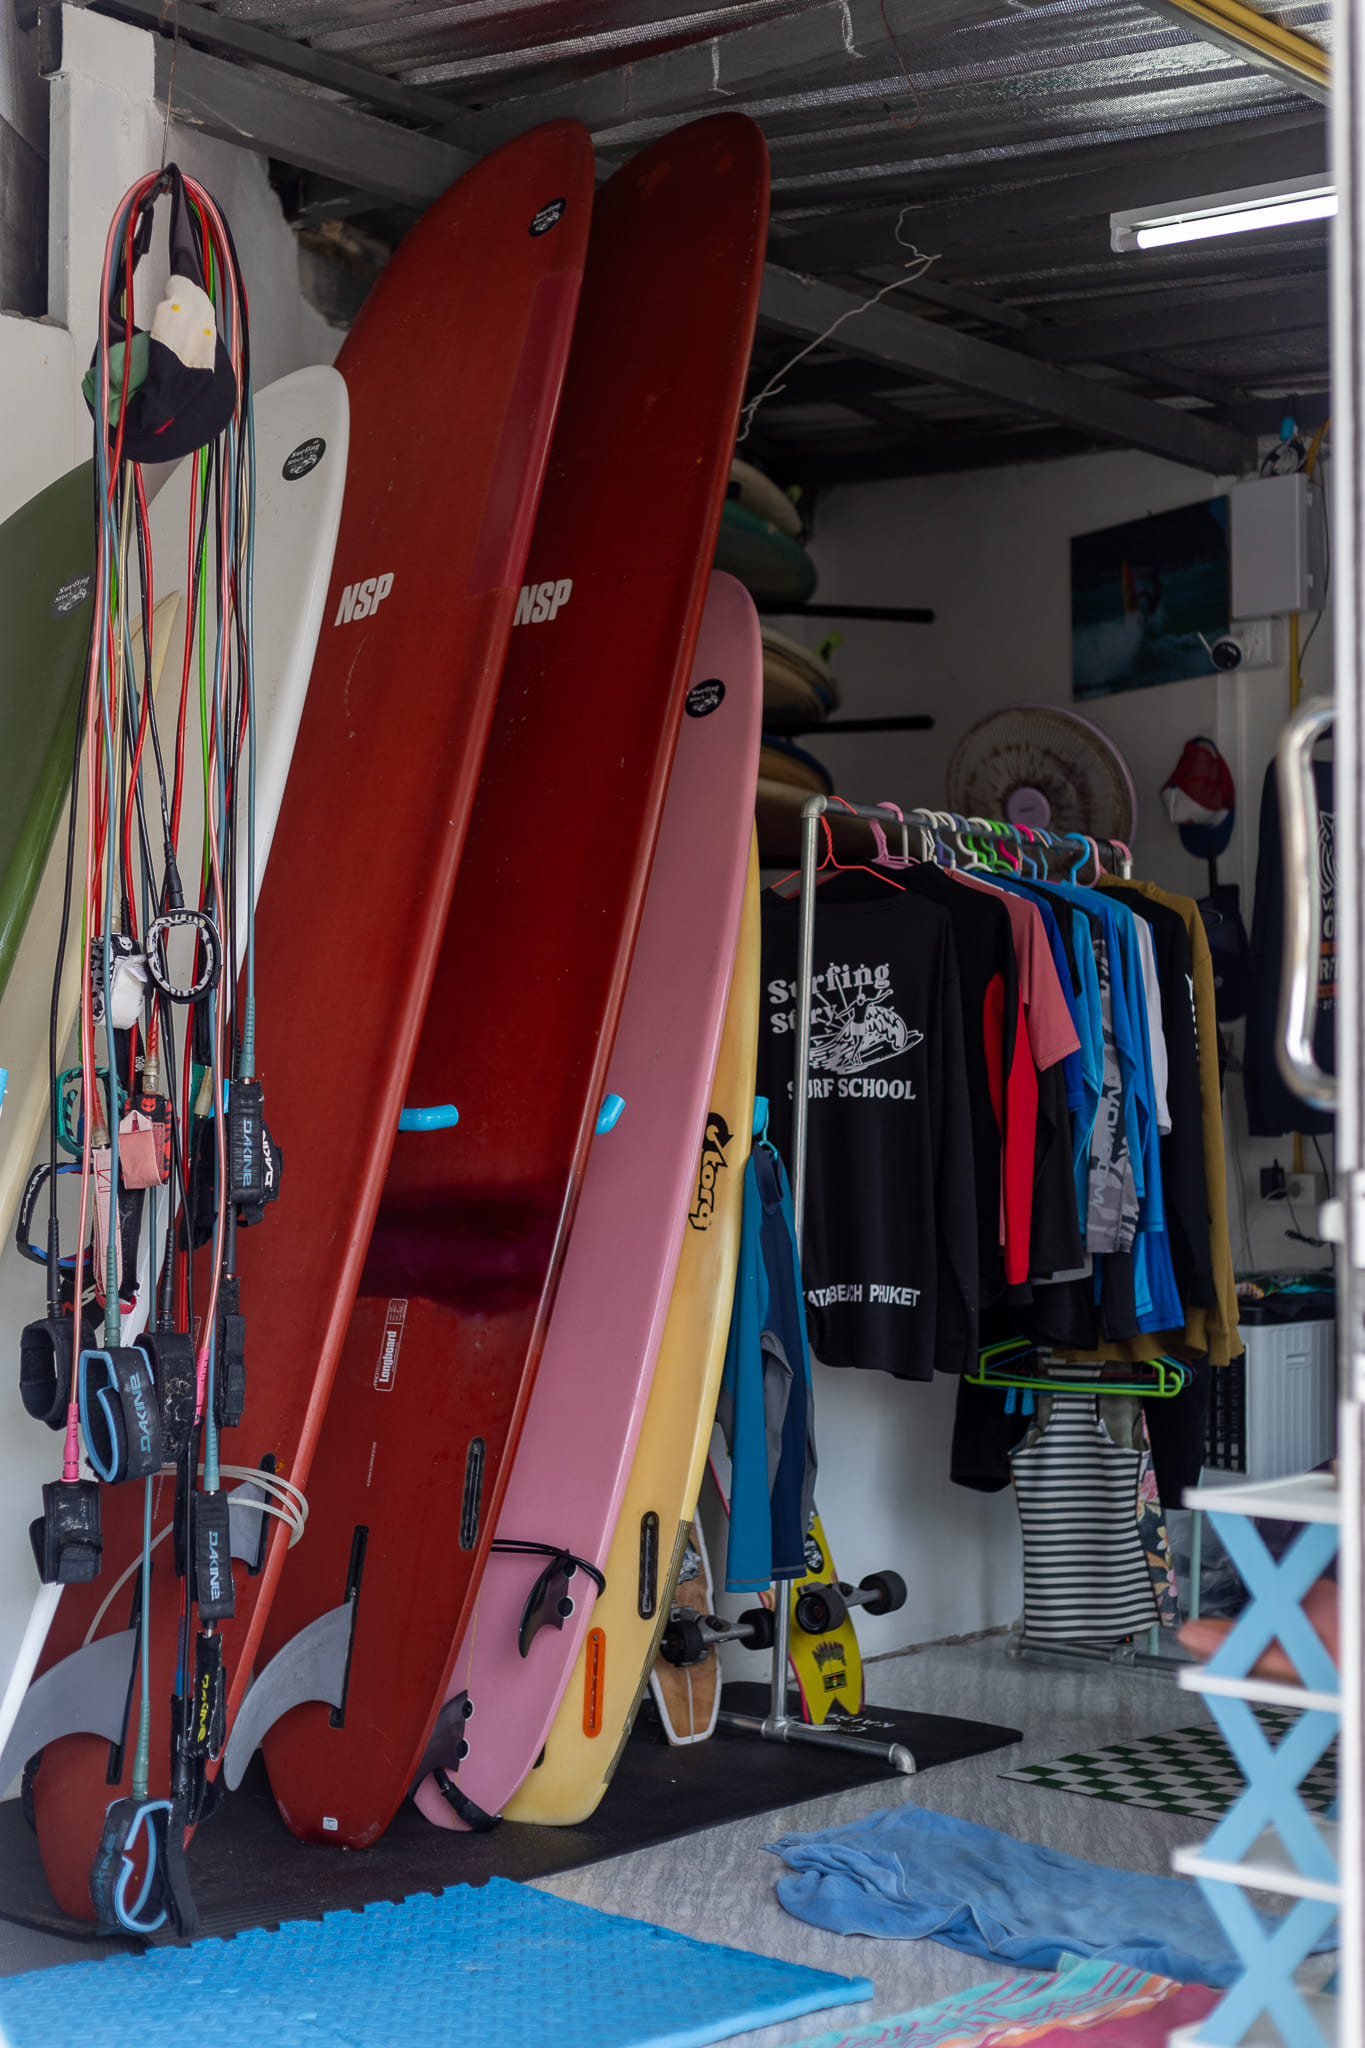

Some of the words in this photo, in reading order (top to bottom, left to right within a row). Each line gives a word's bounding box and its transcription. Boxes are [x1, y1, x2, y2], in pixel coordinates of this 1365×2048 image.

[334, 572, 395, 627] NSP
[513, 578, 573, 626] NSP
[838, 1077, 917, 1101] SCHOOL
[242, 1118, 253, 1188] DAKINE
[378, 1330, 398, 1383] Longboard
[129, 1371, 152, 1454] DAKINE
[208, 1530, 221, 1602] DAKINE
